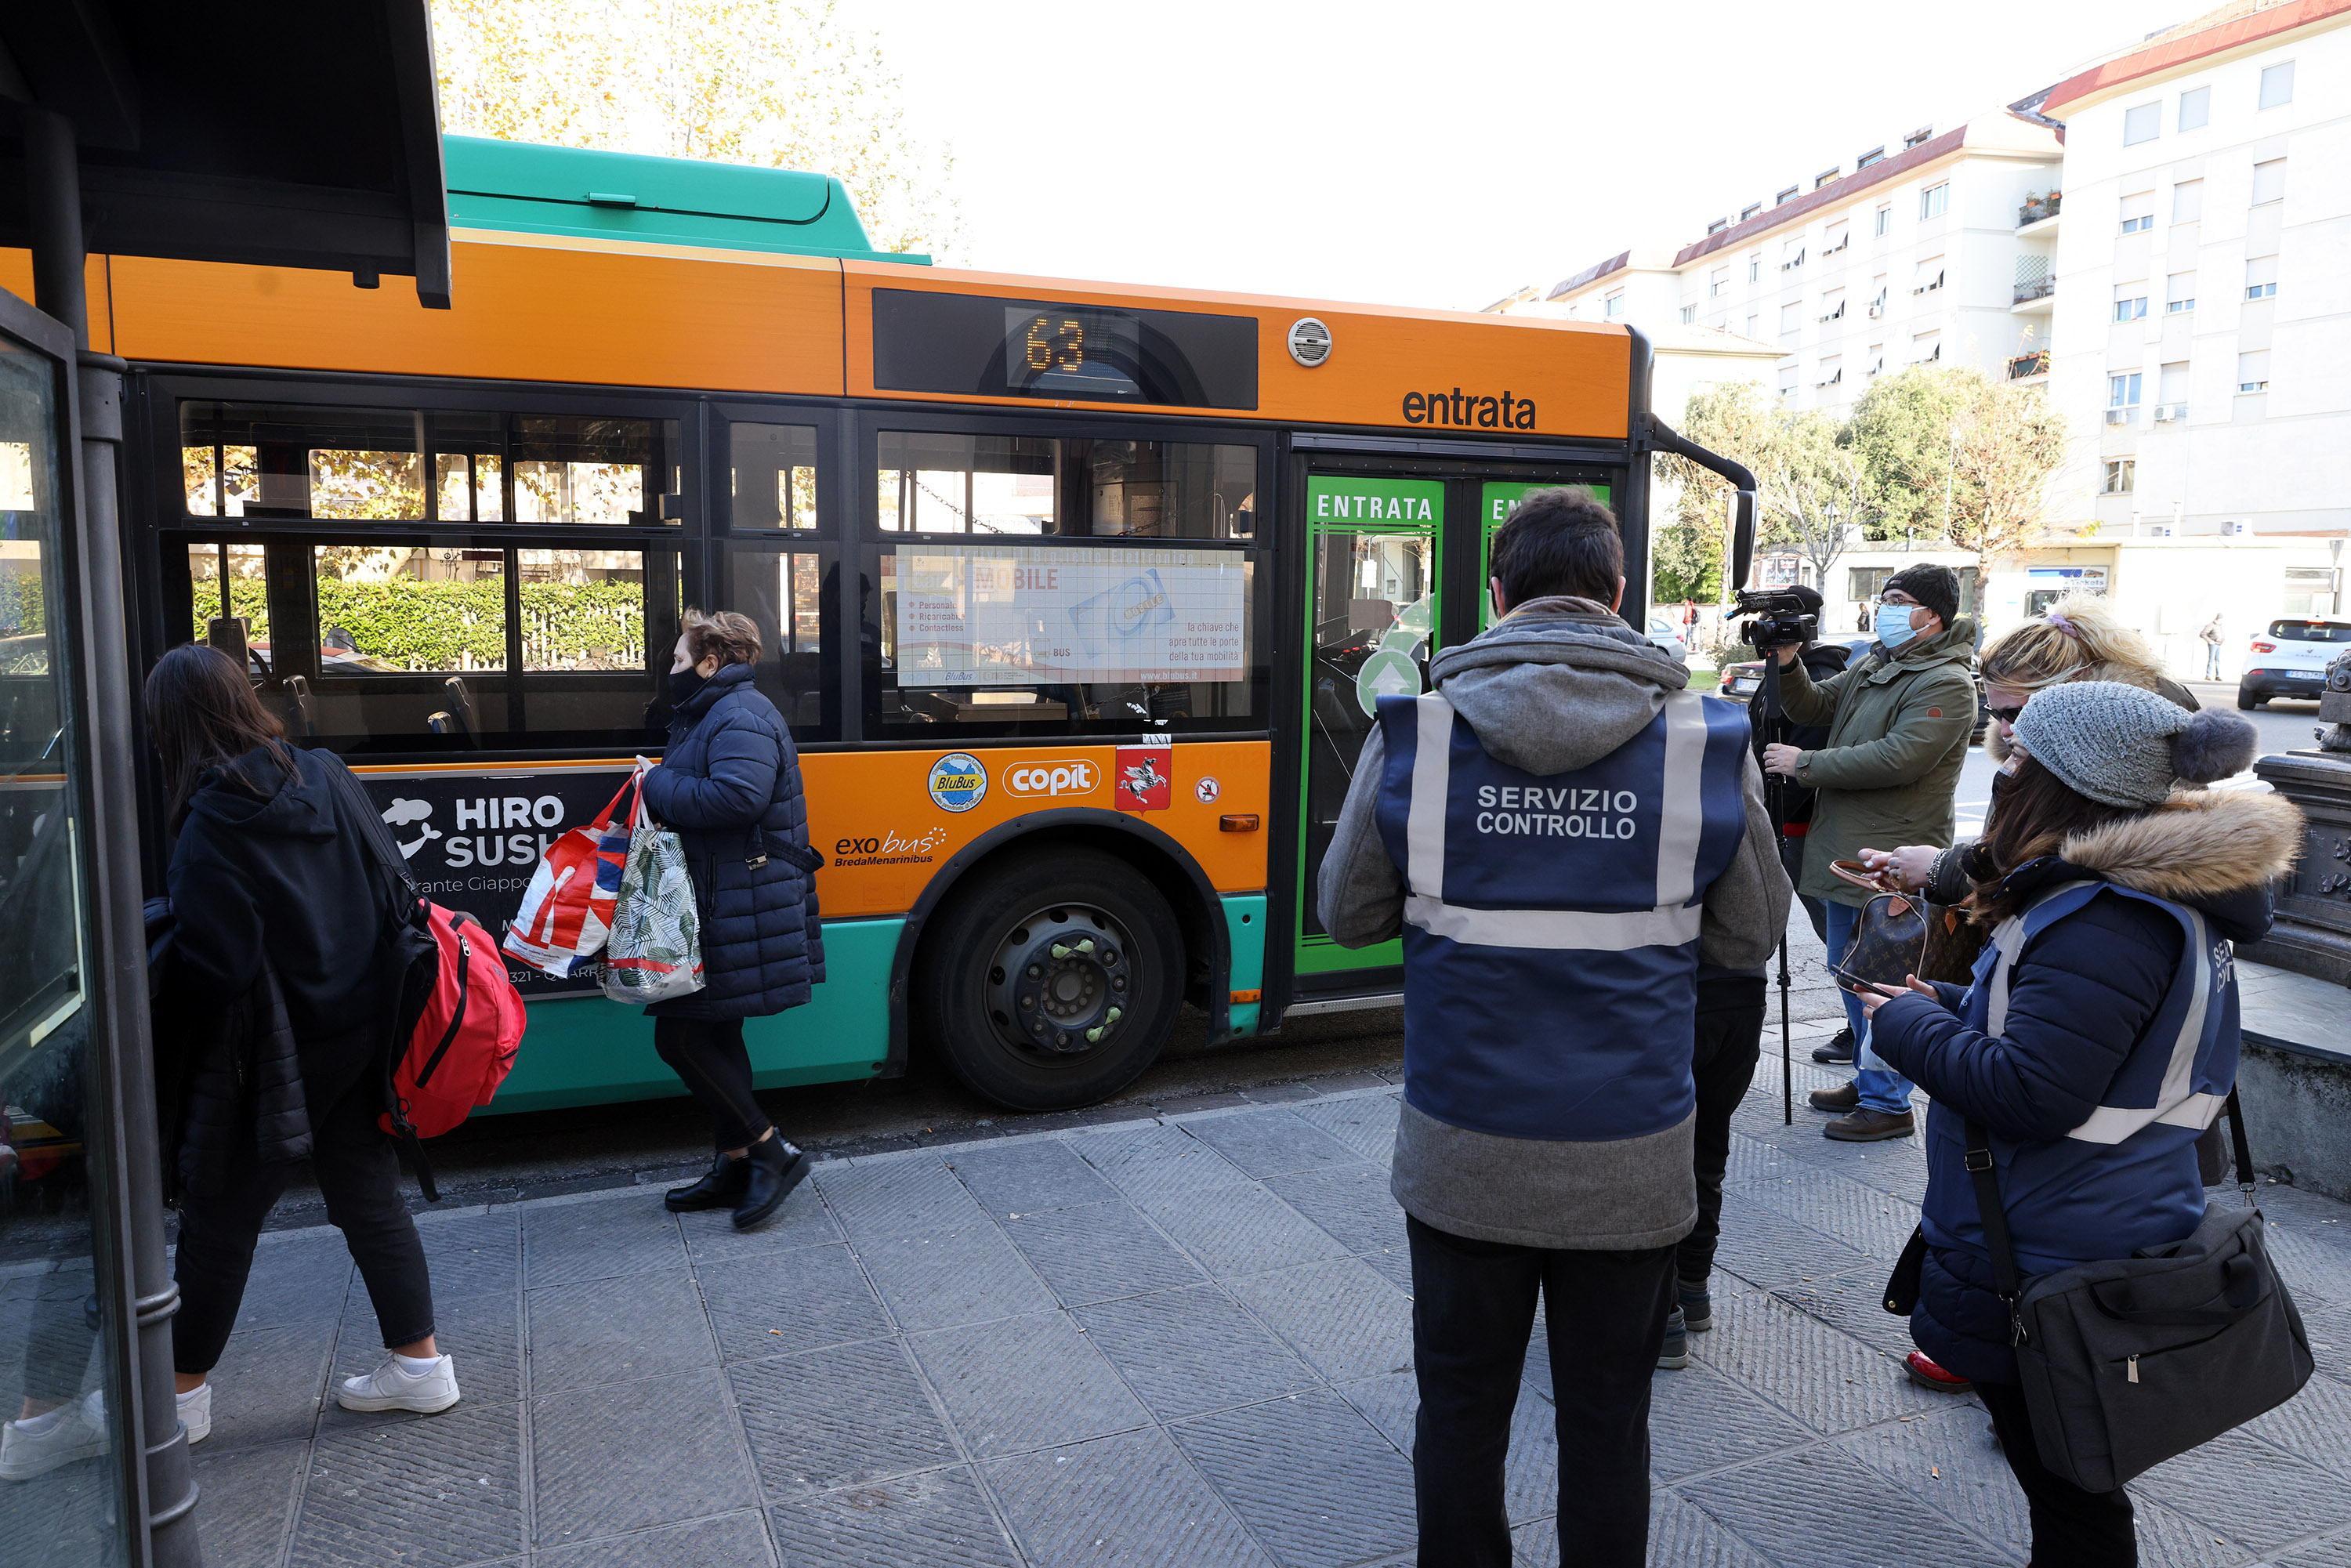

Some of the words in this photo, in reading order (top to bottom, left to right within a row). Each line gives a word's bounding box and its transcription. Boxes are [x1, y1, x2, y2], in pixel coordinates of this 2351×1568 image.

[1027, 318, 1083, 371] 63
[1403, 387, 1536, 429] entrata
[1317, 494, 1433, 520] ENTRATA
[1188, 622, 1195, 632] la
[1197, 622, 1223, 632] chiave
[1225, 622, 1239, 632] che
[1169, 639, 1186, 648] apre
[1189, 637, 1208, 646] tutte
[1210, 637, 1217, 646] le
[1219, 637, 1239, 648] porte
[1169, 651, 1188, 661] della
[1191, 652, 1204, 661] tua
[1207, 651, 1238, 661] mobilità
[945, 672, 973, 681] BluBus
[1140, 671, 1198, 680] www.blubus.it
[937, 776, 976, 790] BluBus
[1012, 764, 1092, 796] copit
[1477, 785, 1638, 813] SERVIZIO
[455, 795, 565, 831] HIRO
[1476, 811, 1636, 840] CONTROLLO
[835, 837, 879, 855] exo
[882, 829, 934, 853] bus
[835, 855, 933, 867] BredaMenarinibus
[468, 875, 534, 893] Giappo
